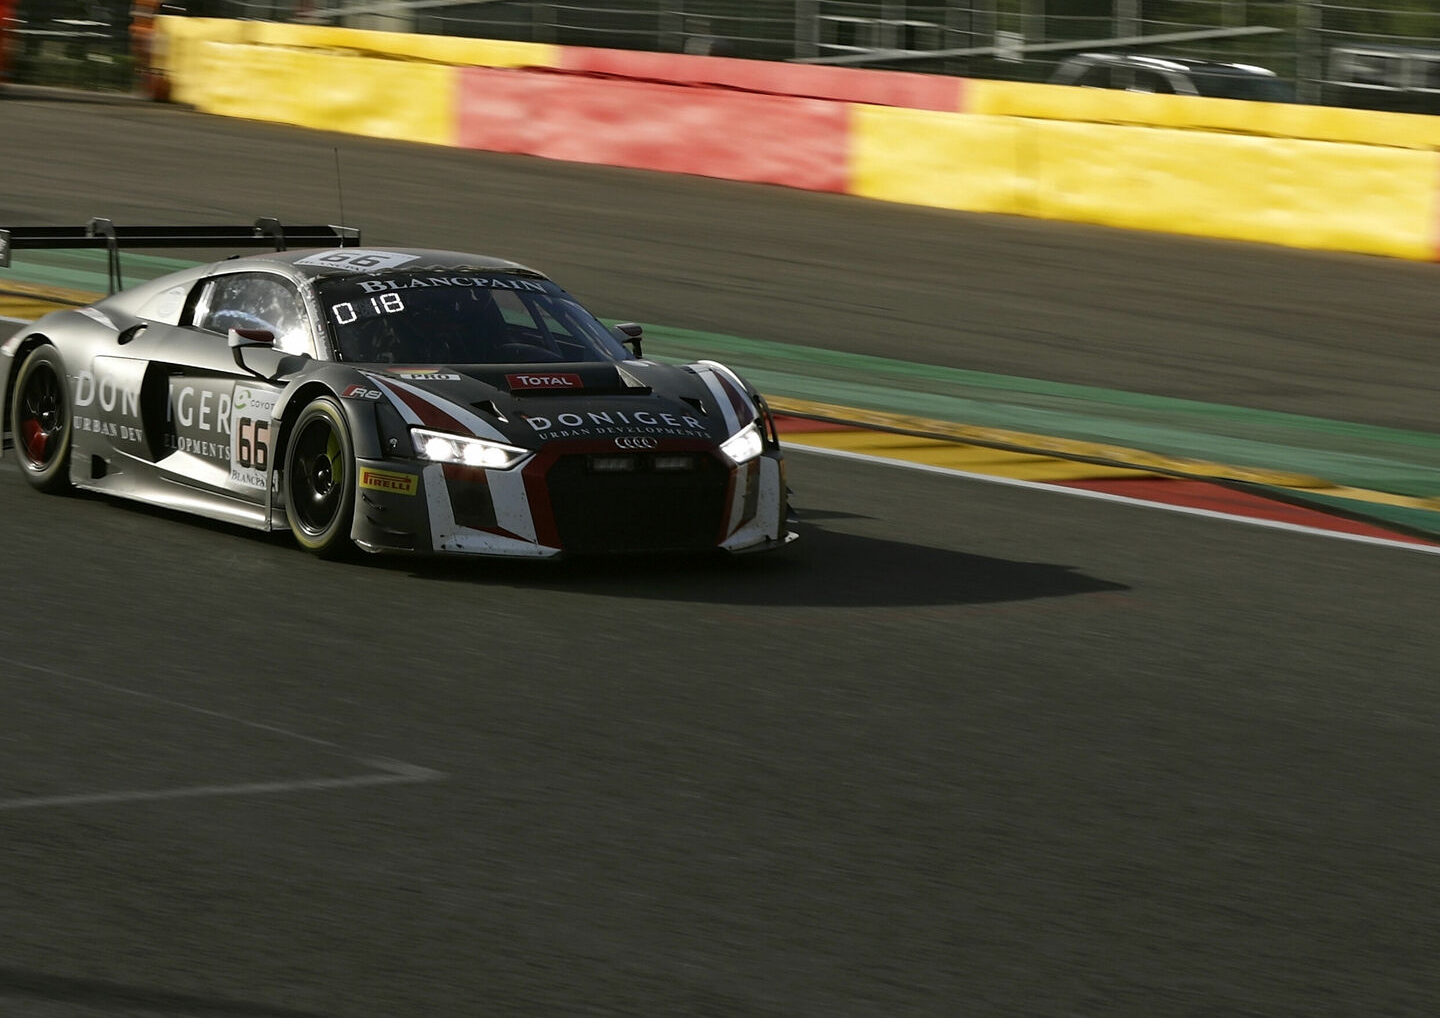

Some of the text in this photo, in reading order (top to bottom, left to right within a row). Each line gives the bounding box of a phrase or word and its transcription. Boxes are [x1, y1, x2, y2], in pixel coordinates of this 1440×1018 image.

[320, 253, 391, 267] 66
[357, 277, 548, 294] BLANCPAIN
[517, 376, 573, 387] TOTAL
[350, 387, 382, 399] R8
[250, 399, 275, 410] COYOT
[73, 415, 118, 437] URBAN
[526, 411, 707, 431] DONIGER
[539, 428, 591, 440] URBAN
[240, 417, 268, 471] 66
[364, 472, 411, 490] PIRELLI
